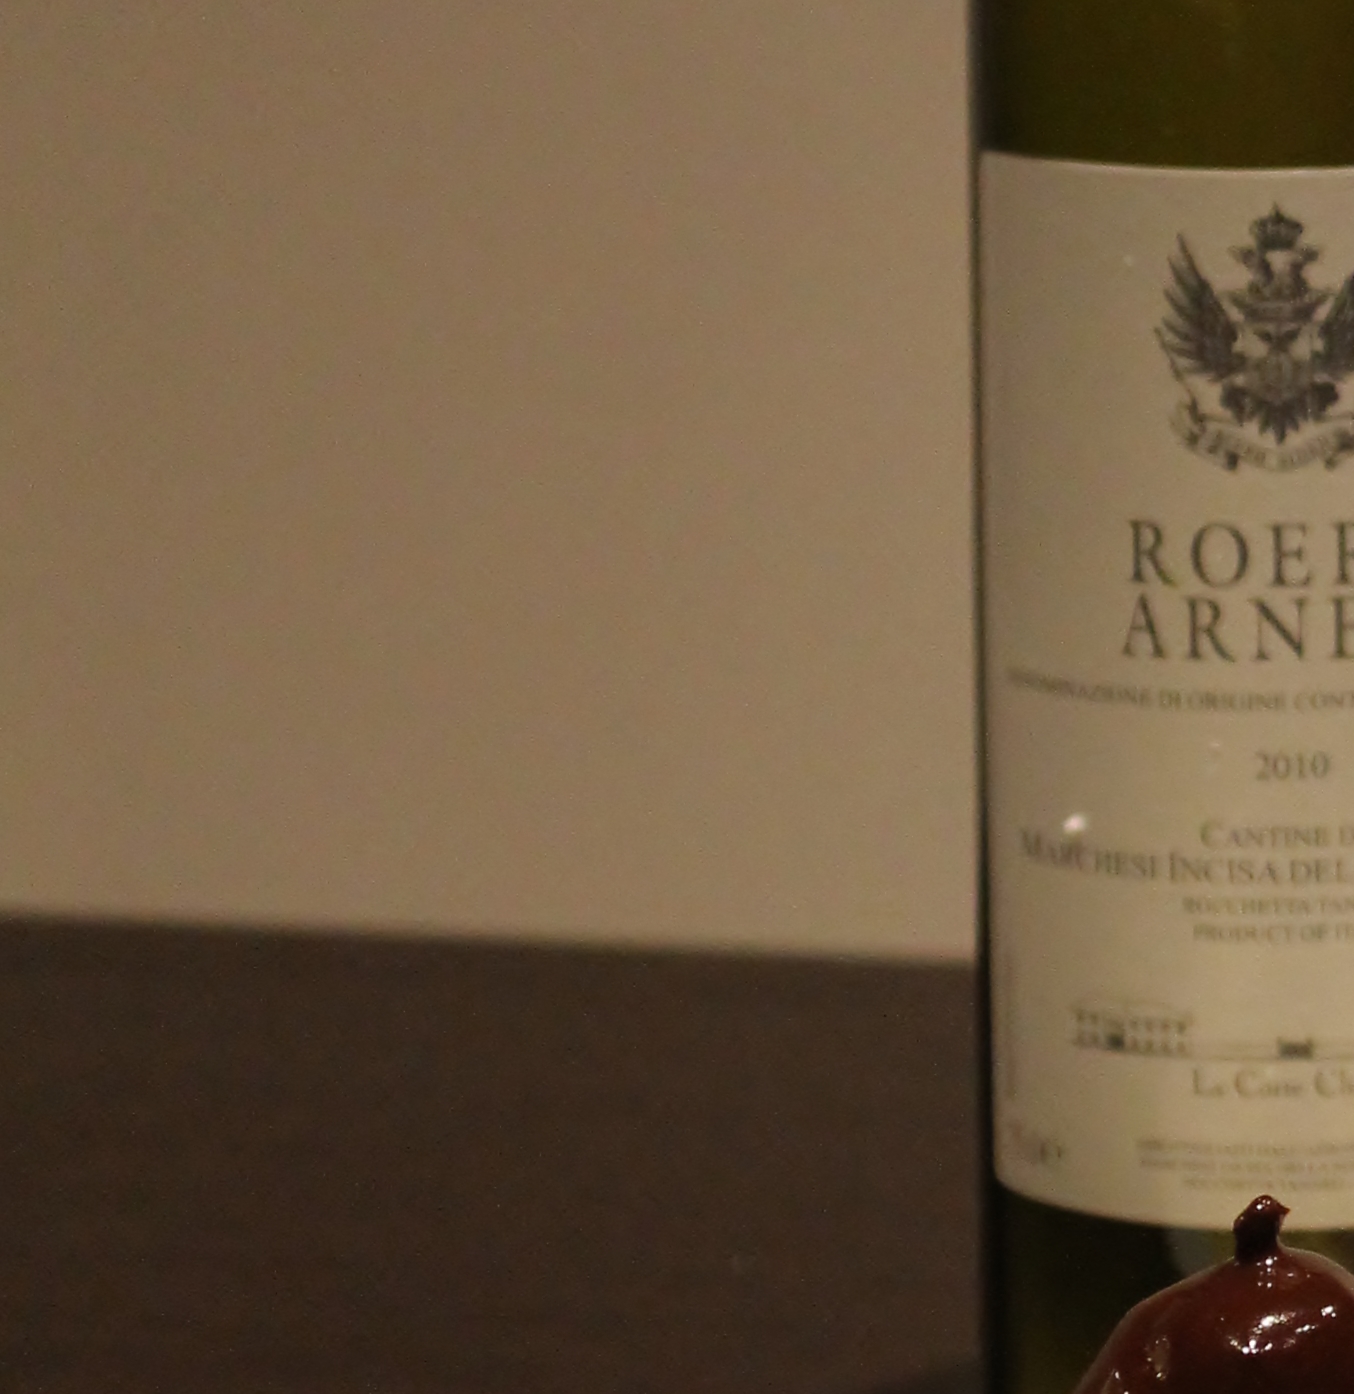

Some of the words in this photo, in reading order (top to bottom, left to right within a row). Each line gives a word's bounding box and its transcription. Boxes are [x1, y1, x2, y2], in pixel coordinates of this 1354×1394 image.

[1006, 664, 1151, 706] NOMINAZIONE
[1185, 688, 1288, 713] ORIGINE
[1254, 749, 1332, 782] 2010
[1199, 818, 1331, 850] CANTINE
[1019, 827, 1157, 882] MARCHESI
[1167, 849, 1282, 886] INCISA
[1192, 923, 1293, 943] PRODUCT
[1299, 923, 1328, 942] OF
